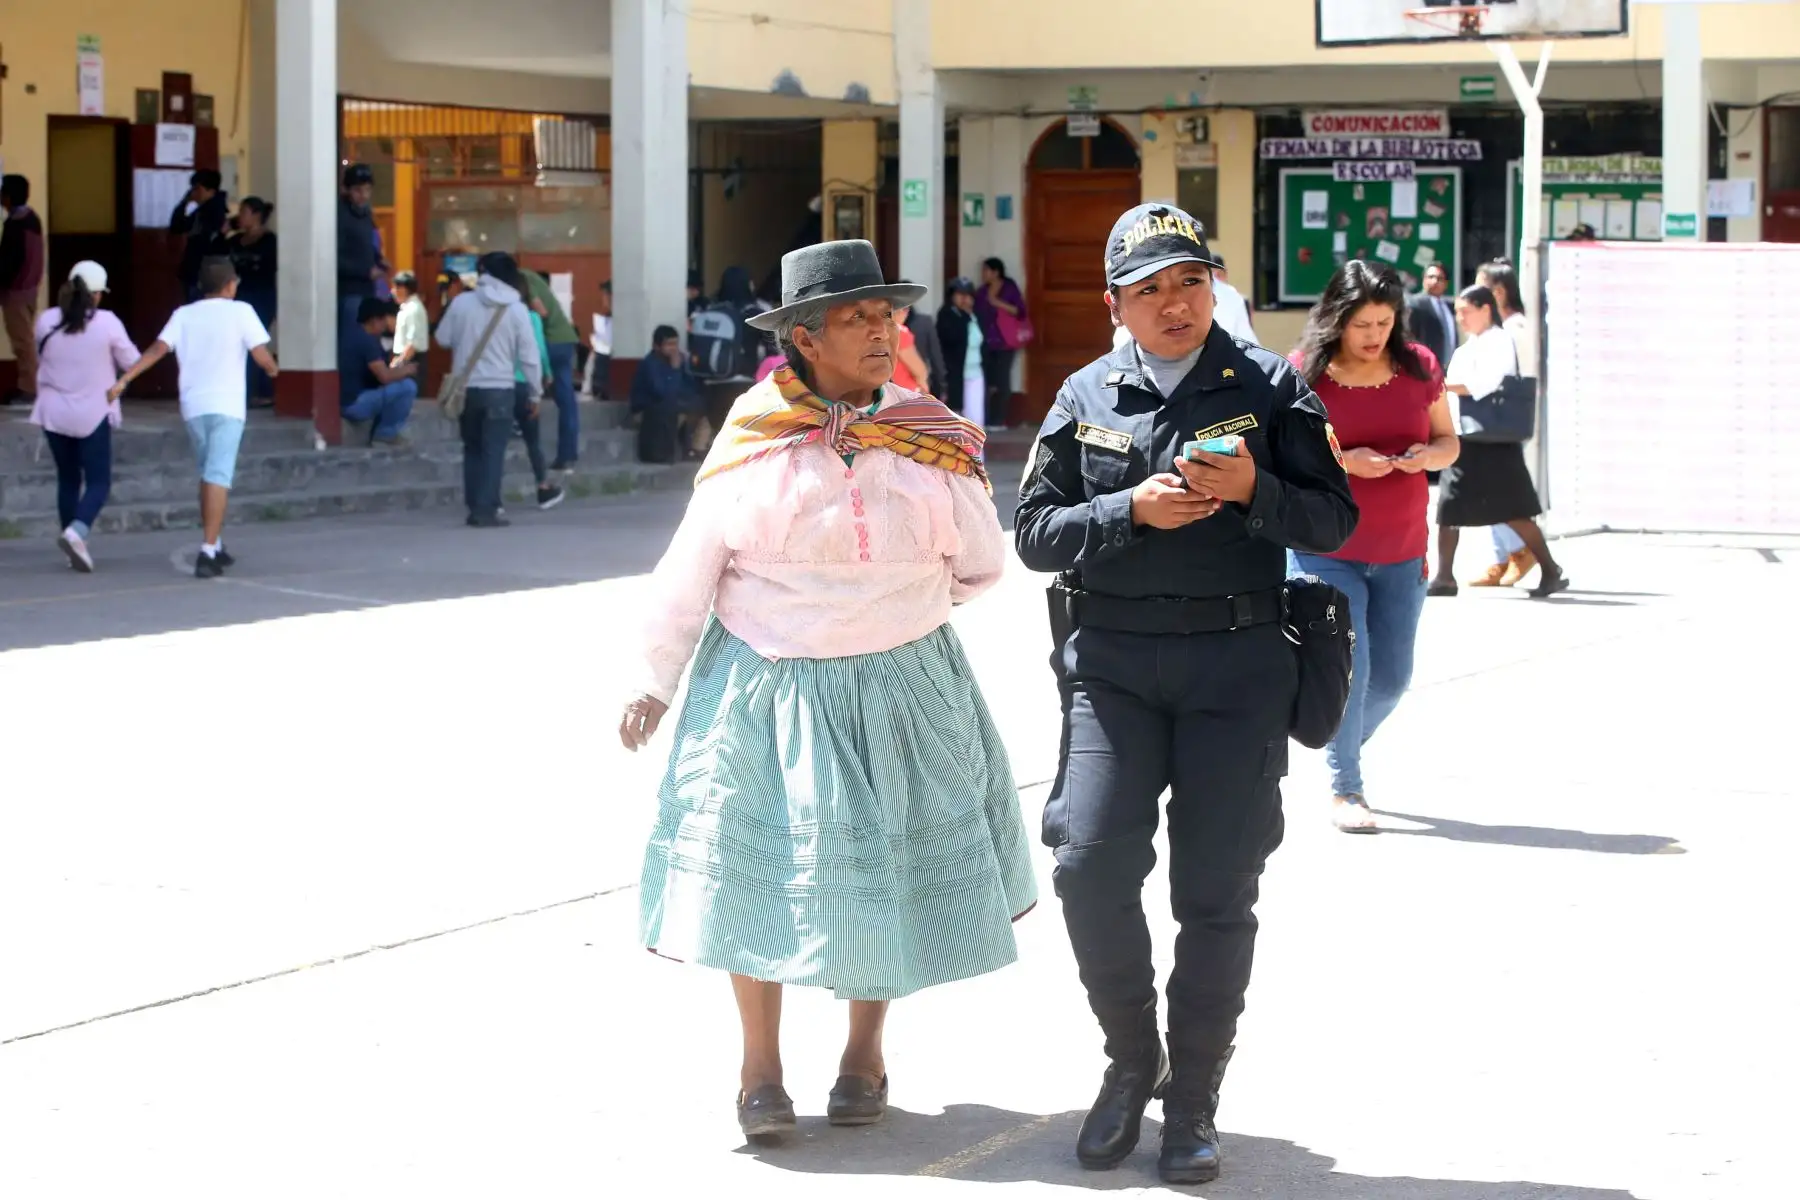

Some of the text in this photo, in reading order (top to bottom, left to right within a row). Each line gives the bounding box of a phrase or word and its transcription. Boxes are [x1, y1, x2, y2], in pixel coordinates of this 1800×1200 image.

[1264, 139, 1479, 158] SEMANA DE LA BIBLIOTECA
[1338, 162, 1413, 179] ESCOLAR
[1122, 214, 1201, 257] POLICIA
[1223, 418, 1253, 432] NACIONAL
